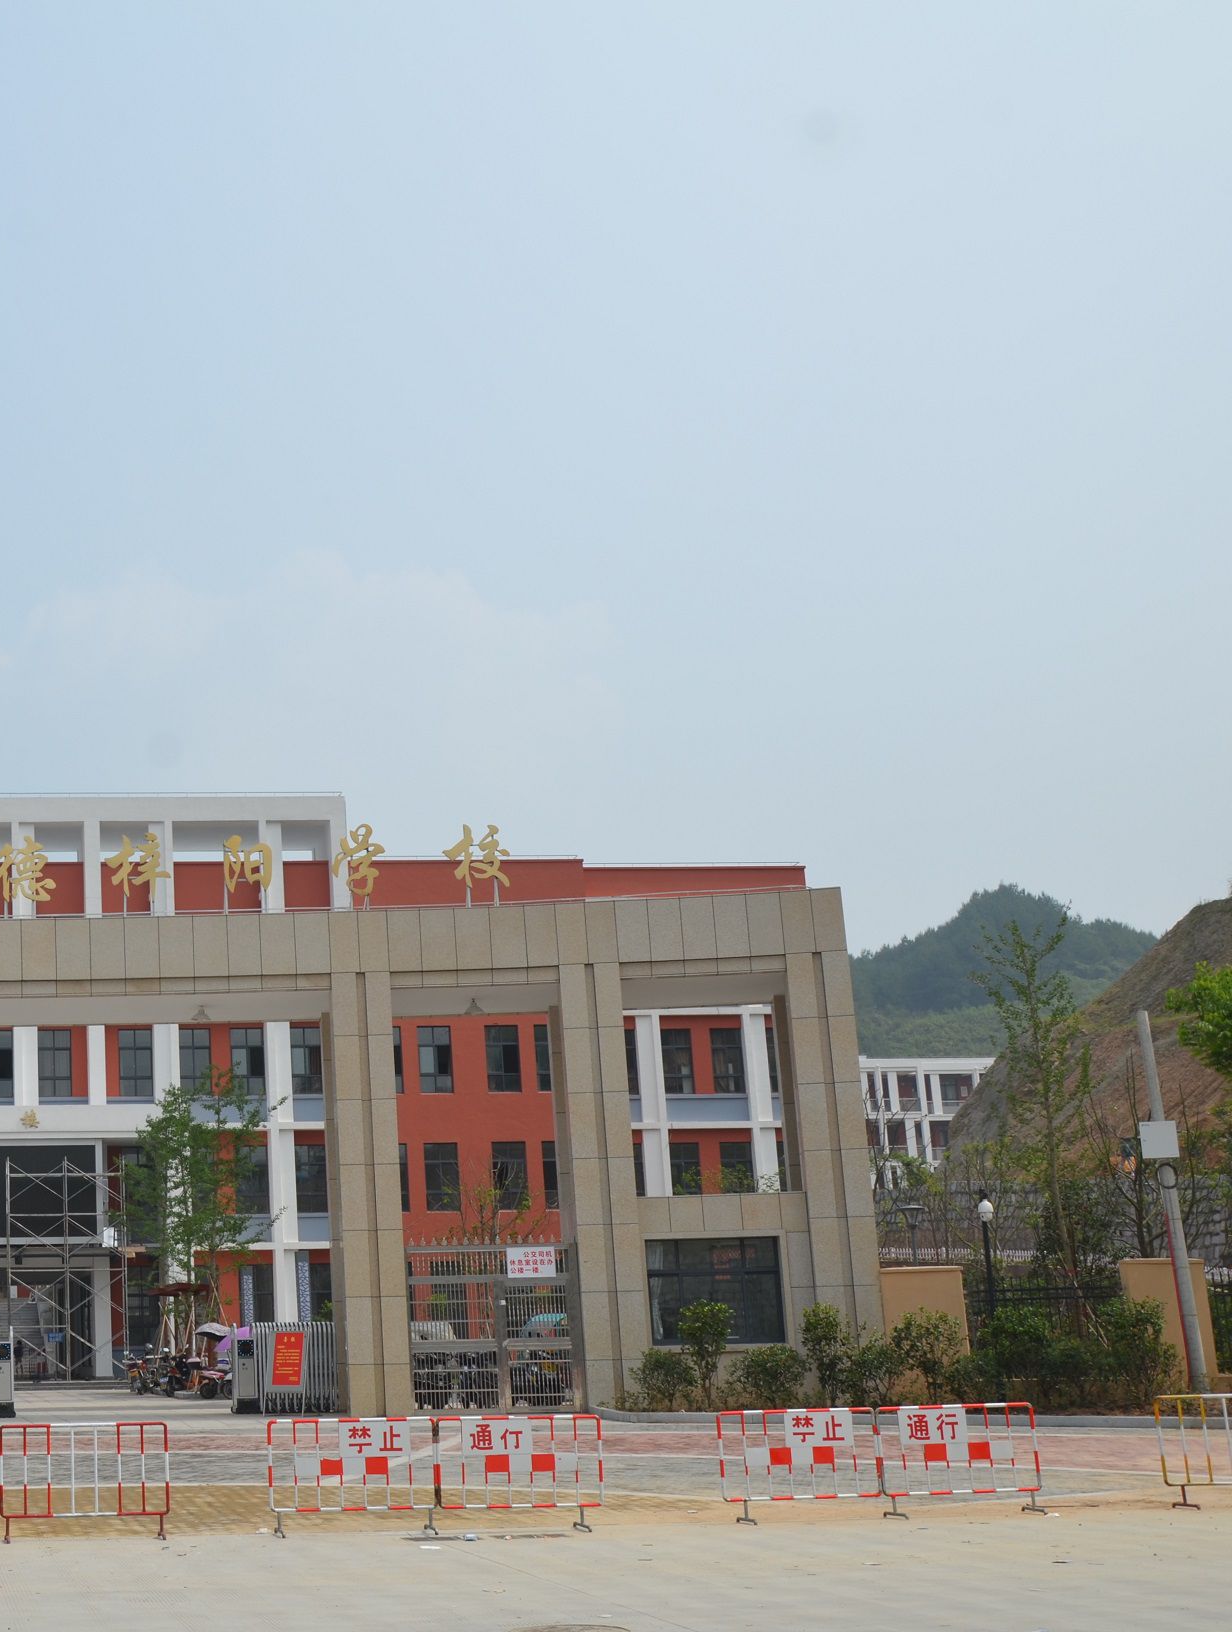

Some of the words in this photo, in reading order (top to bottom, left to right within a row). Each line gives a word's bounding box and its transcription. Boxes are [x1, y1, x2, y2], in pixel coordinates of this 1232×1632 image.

[348, 1425, 403, 1454] 禁止
[792, 1414, 845, 1443] 禁止
[906, 1413, 959, 1441] 通行
